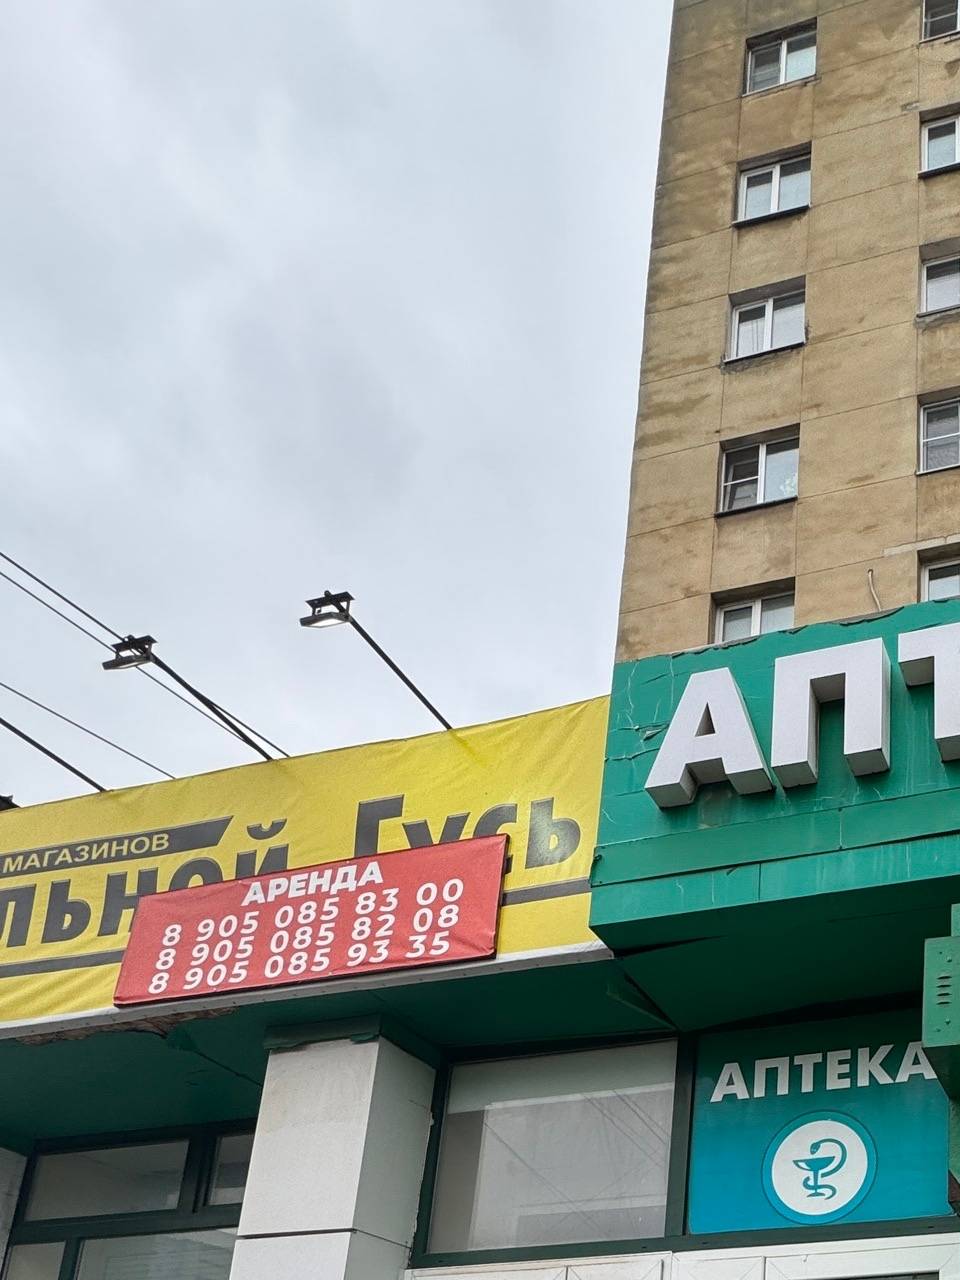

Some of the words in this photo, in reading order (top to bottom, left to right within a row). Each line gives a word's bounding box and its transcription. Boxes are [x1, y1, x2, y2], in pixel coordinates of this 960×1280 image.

[2, 833, 169, 874] МАГАЗИНОВ
[241, 861, 383, 906] АРЕНДА
[155, 948, 177, 971] 8
[190, 936, 254, 967] 905
[270, 922, 335, 953] 085
[351, 914, 396, 942] 82
[412, 904, 460, 933] 08
[163, 923, 182, 947] 8
[196, 911, 259, 942] 905
[274, 896, 340, 927] 085
[355, 887, 400, 916] 83
[416, 878, 465, 907] 00
[147, 971, 169, 995] 8
[182, 960, 249, 990] 905
[263, 947, 331, 979] 085
[346, 939, 390, 967] 93
[405, 931, 450, 959] 35
[710, 1040, 938, 1103] АПТЕКА
